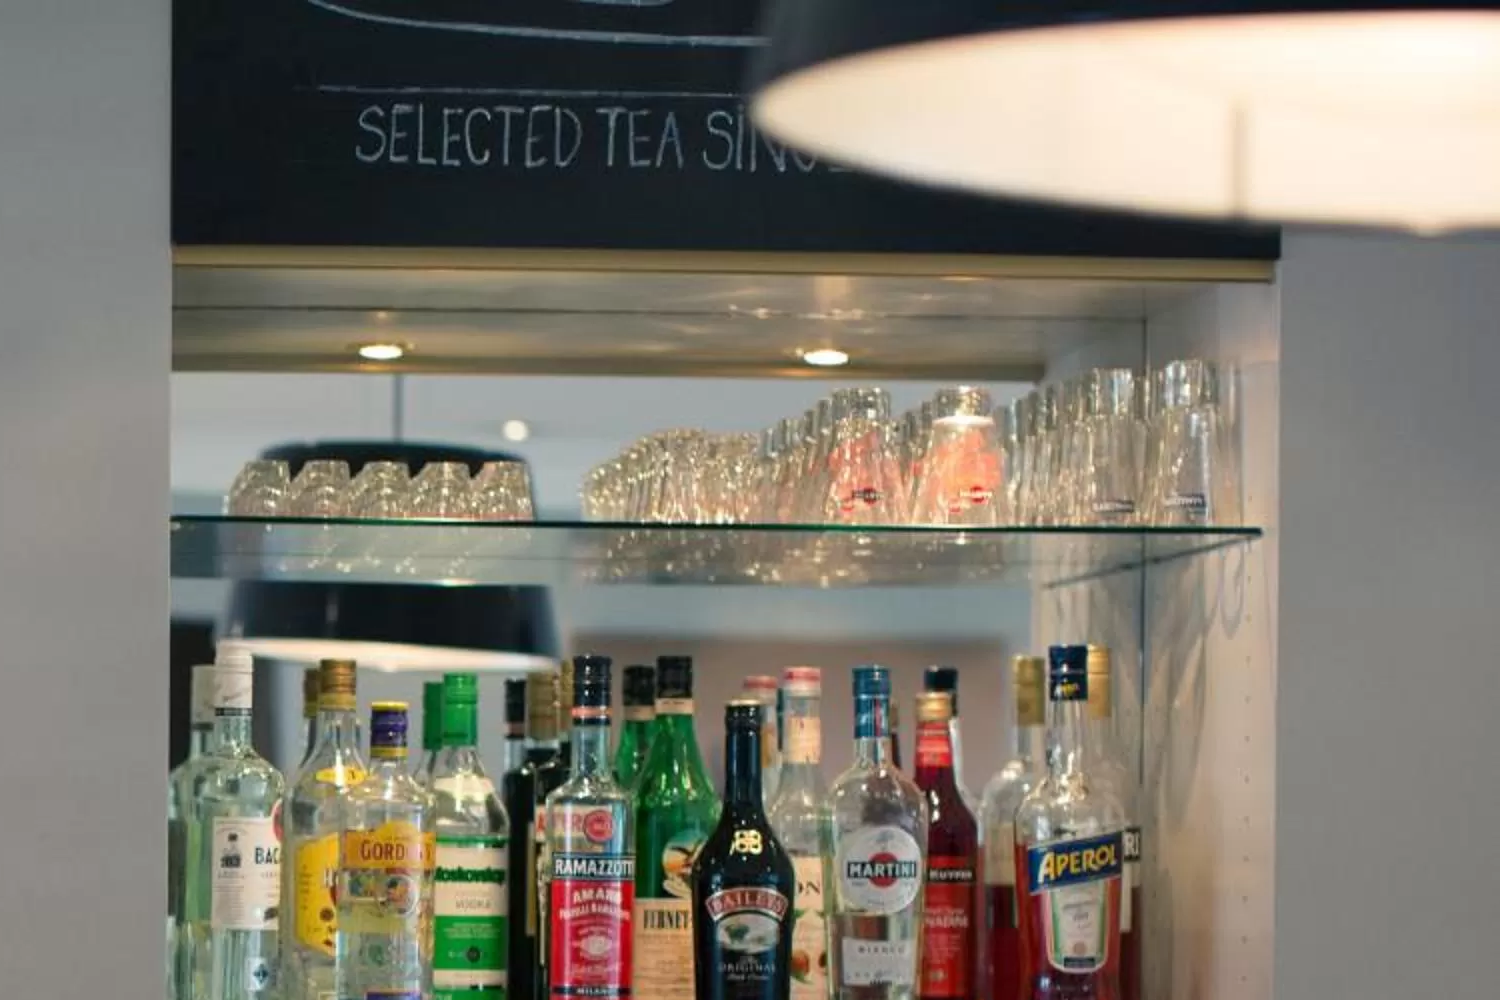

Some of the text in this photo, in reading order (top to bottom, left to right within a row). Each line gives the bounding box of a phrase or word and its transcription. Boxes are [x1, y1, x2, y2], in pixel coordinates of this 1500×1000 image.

[354, 102, 584, 168] SELECTED
[596, 106, 686, 170] TEA
[849, 862, 915, 877] MARTINI
[1038, 844, 1117, 884] APEROL
[709, 889, 786, 916] BAILEYS
[643, 908, 690, 930] FERNET
